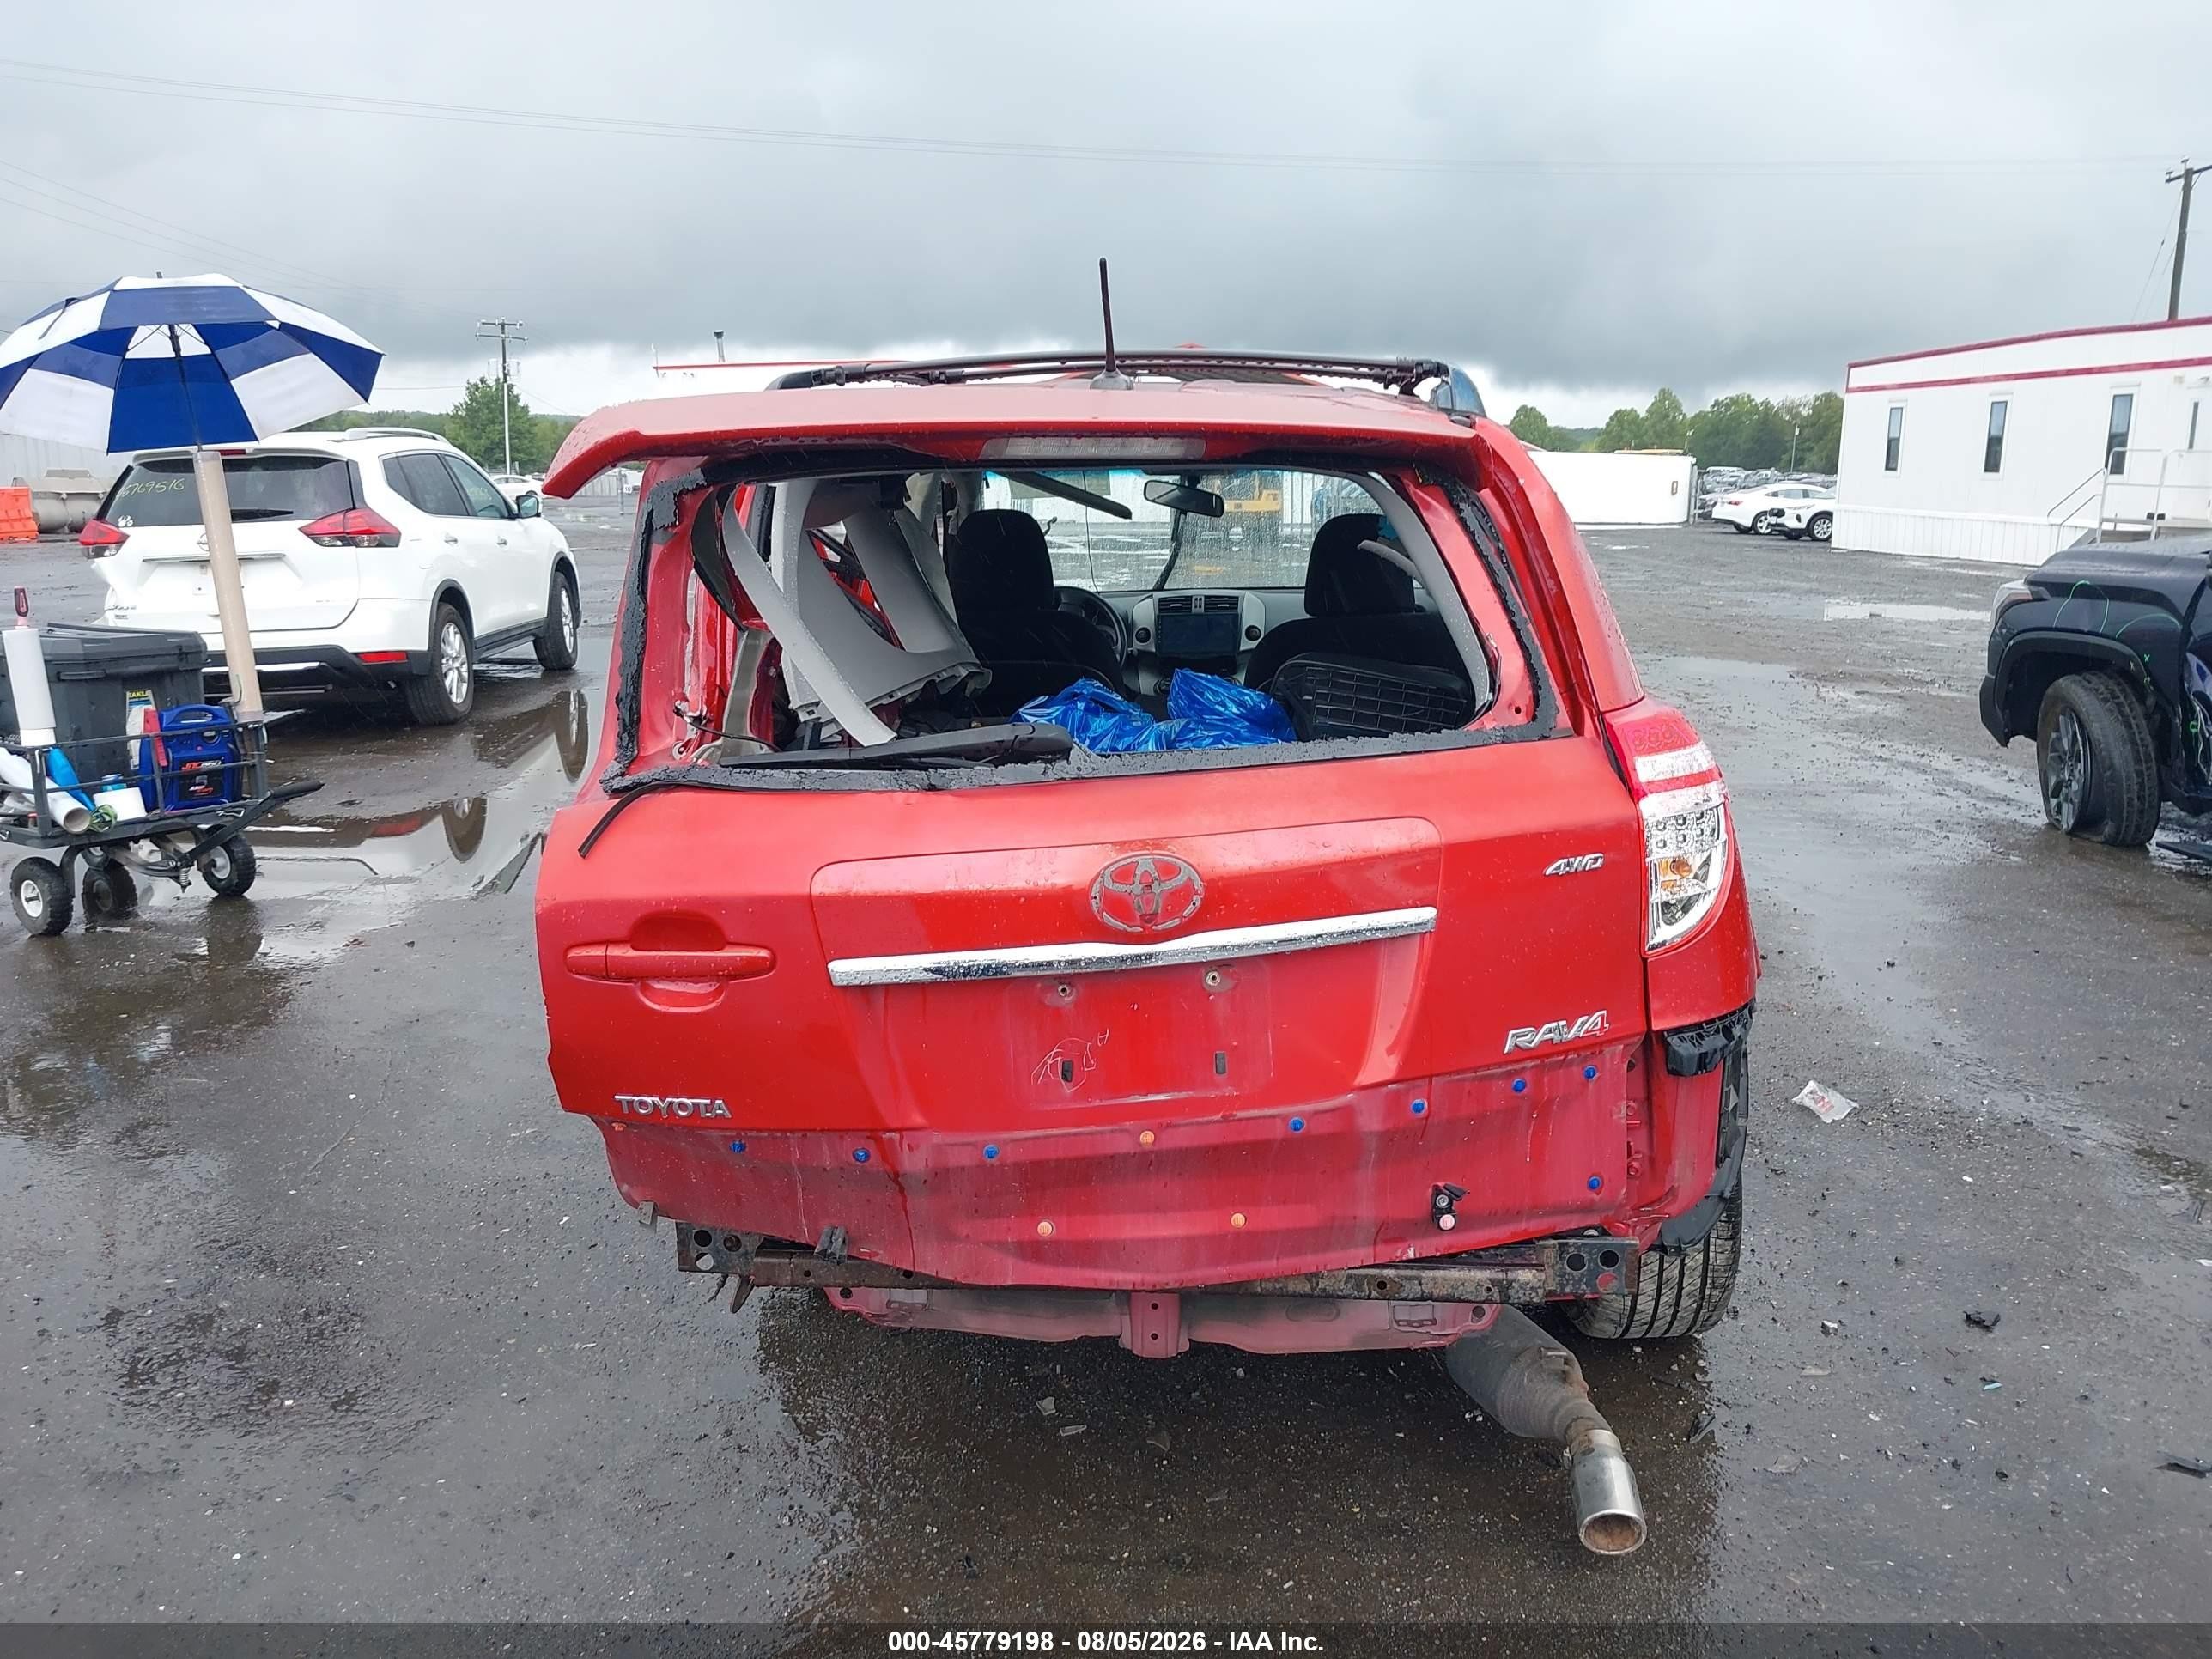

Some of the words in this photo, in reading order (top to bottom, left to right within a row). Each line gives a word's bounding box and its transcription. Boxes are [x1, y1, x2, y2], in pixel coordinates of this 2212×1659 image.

[1543, 853, 1604, 876] 4WD
[1504, 1009, 1610, 1054] RAV4
[613, 1094, 732, 1119] TOYOTA
